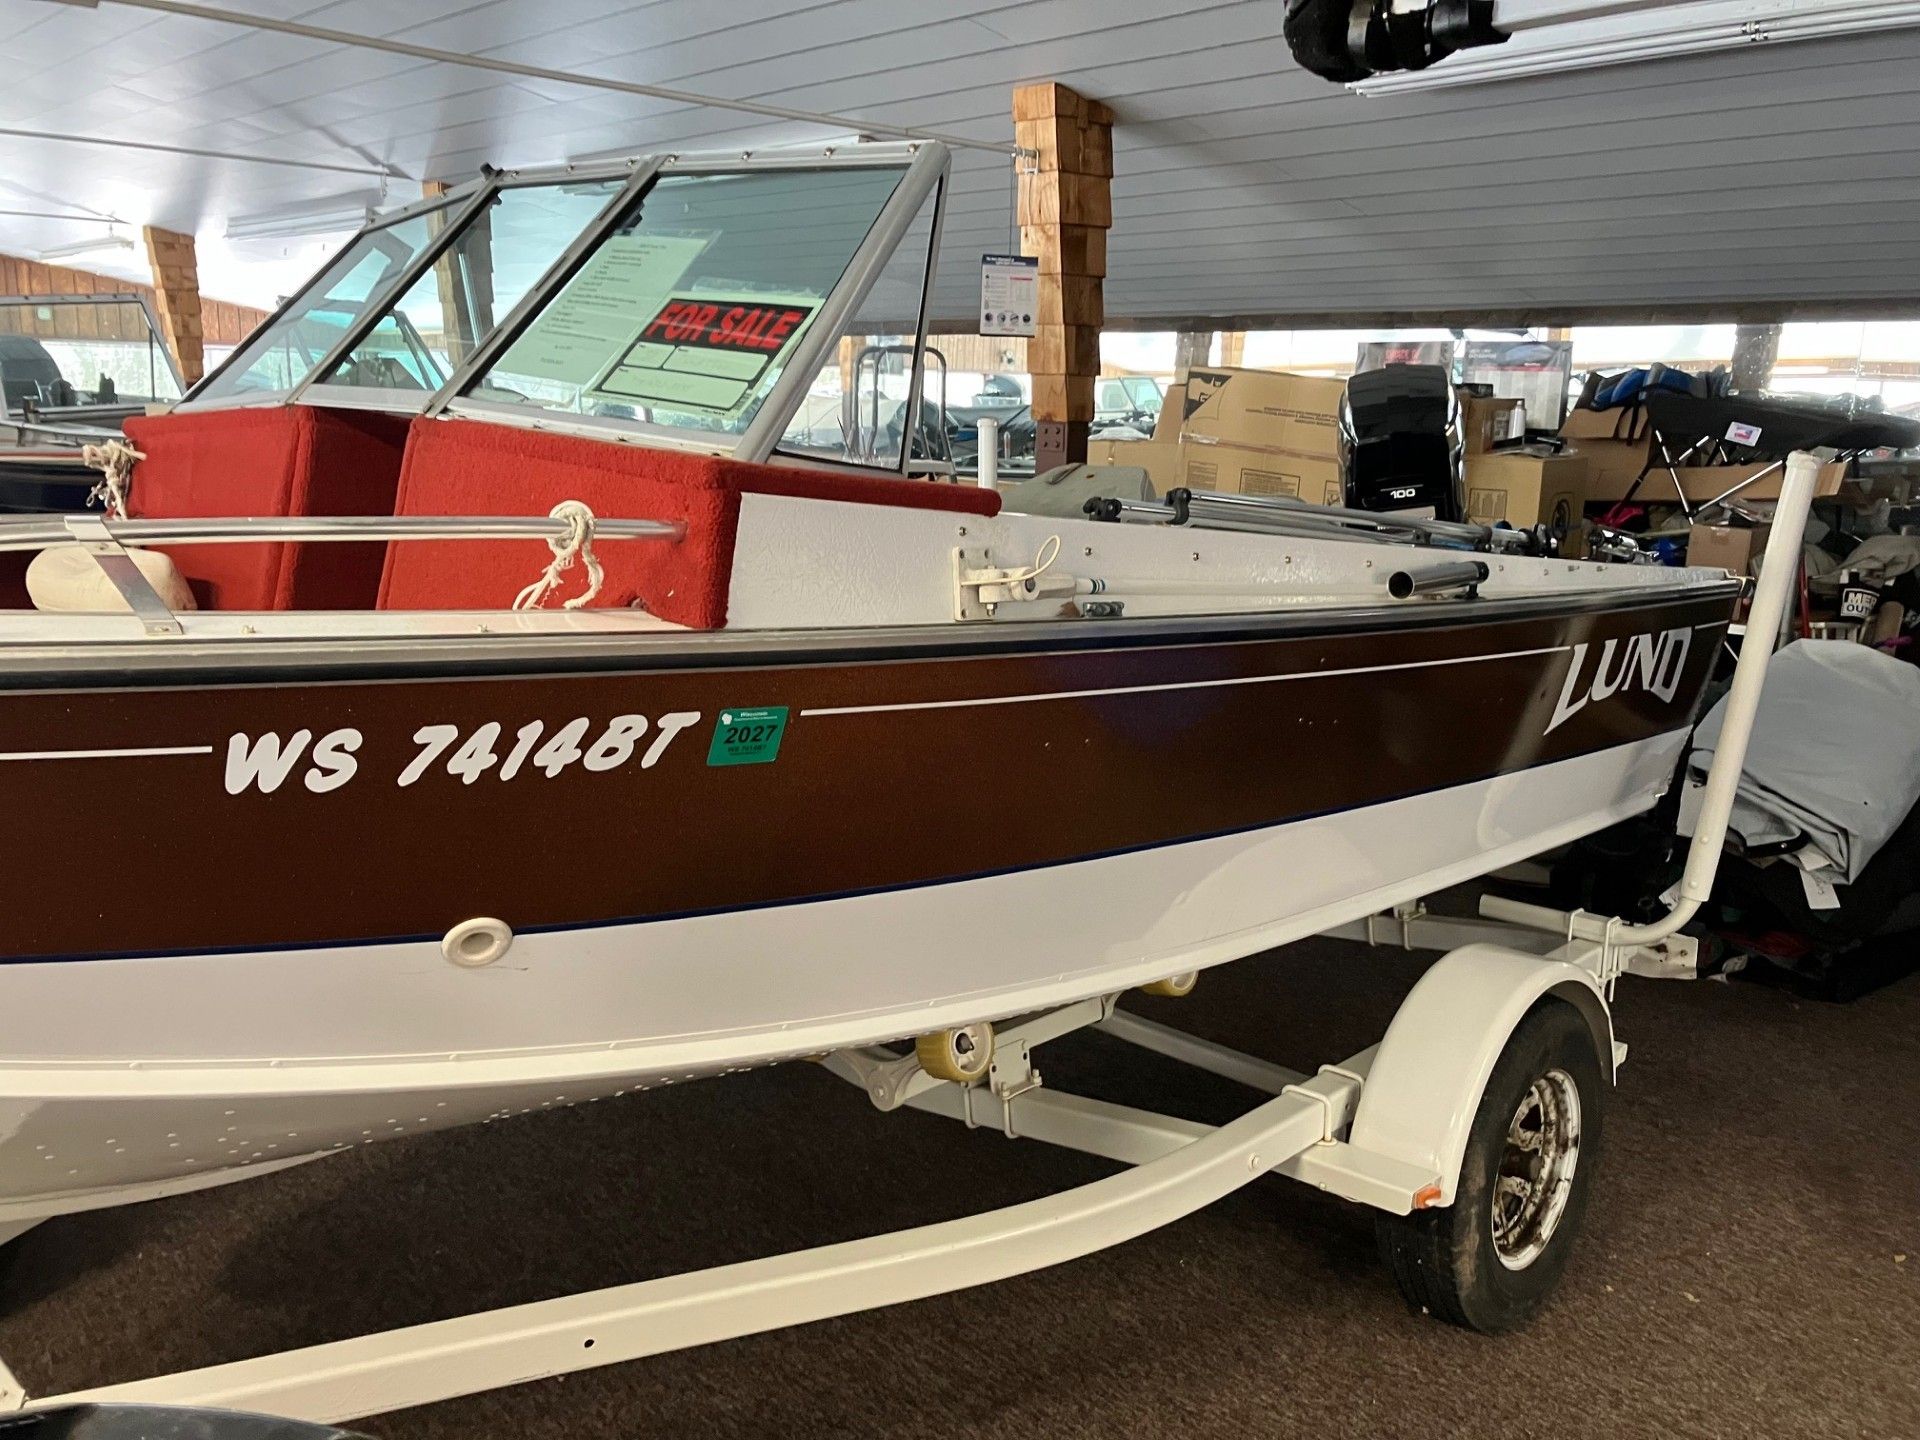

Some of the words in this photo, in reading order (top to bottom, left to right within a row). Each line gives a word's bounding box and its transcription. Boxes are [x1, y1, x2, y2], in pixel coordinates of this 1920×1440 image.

[645, 303, 719, 342] FOR
[709, 306, 803, 349] SALE
[1390, 488, 1416, 499] 100
[1848, 592, 1878, 608] MER
[1543, 627, 1692, 735] LUND
[724, 725, 778, 744] 2027
[225, 728, 362, 794] WS
[398, 712, 700, 786] 7414BT
